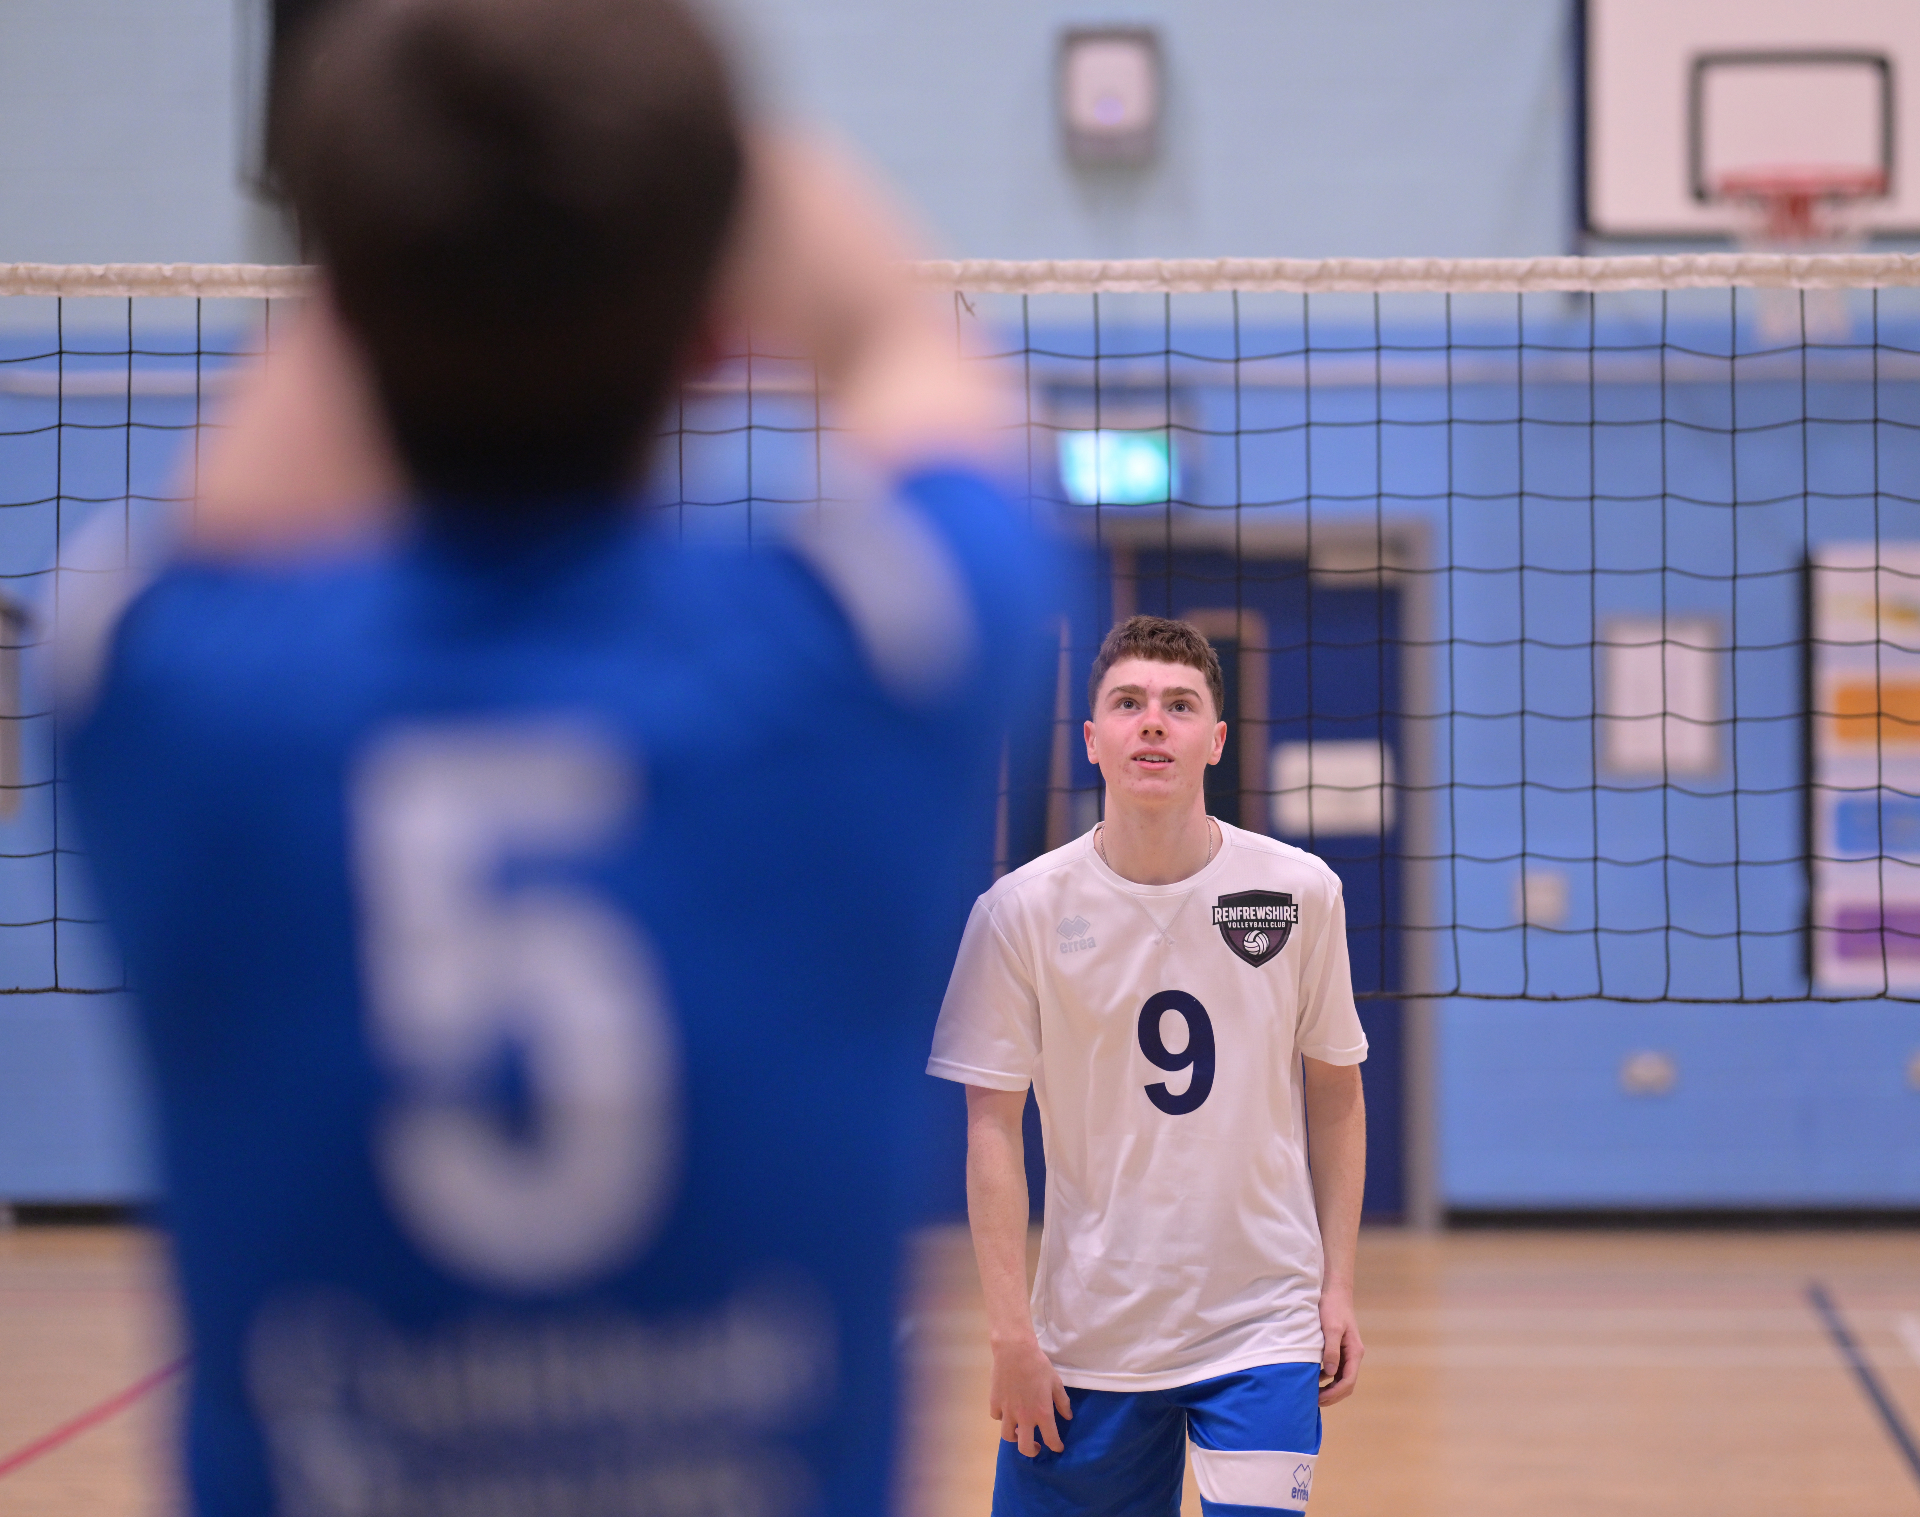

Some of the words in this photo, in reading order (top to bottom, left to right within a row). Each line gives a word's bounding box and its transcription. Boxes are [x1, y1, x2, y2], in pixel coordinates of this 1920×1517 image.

[1060, 937, 1096, 954] errea
[1214, 905, 1297, 923] RENFREWSHIRE
[350, 722, 682, 1290] 5
[1138, 989, 1215, 1116] 9
